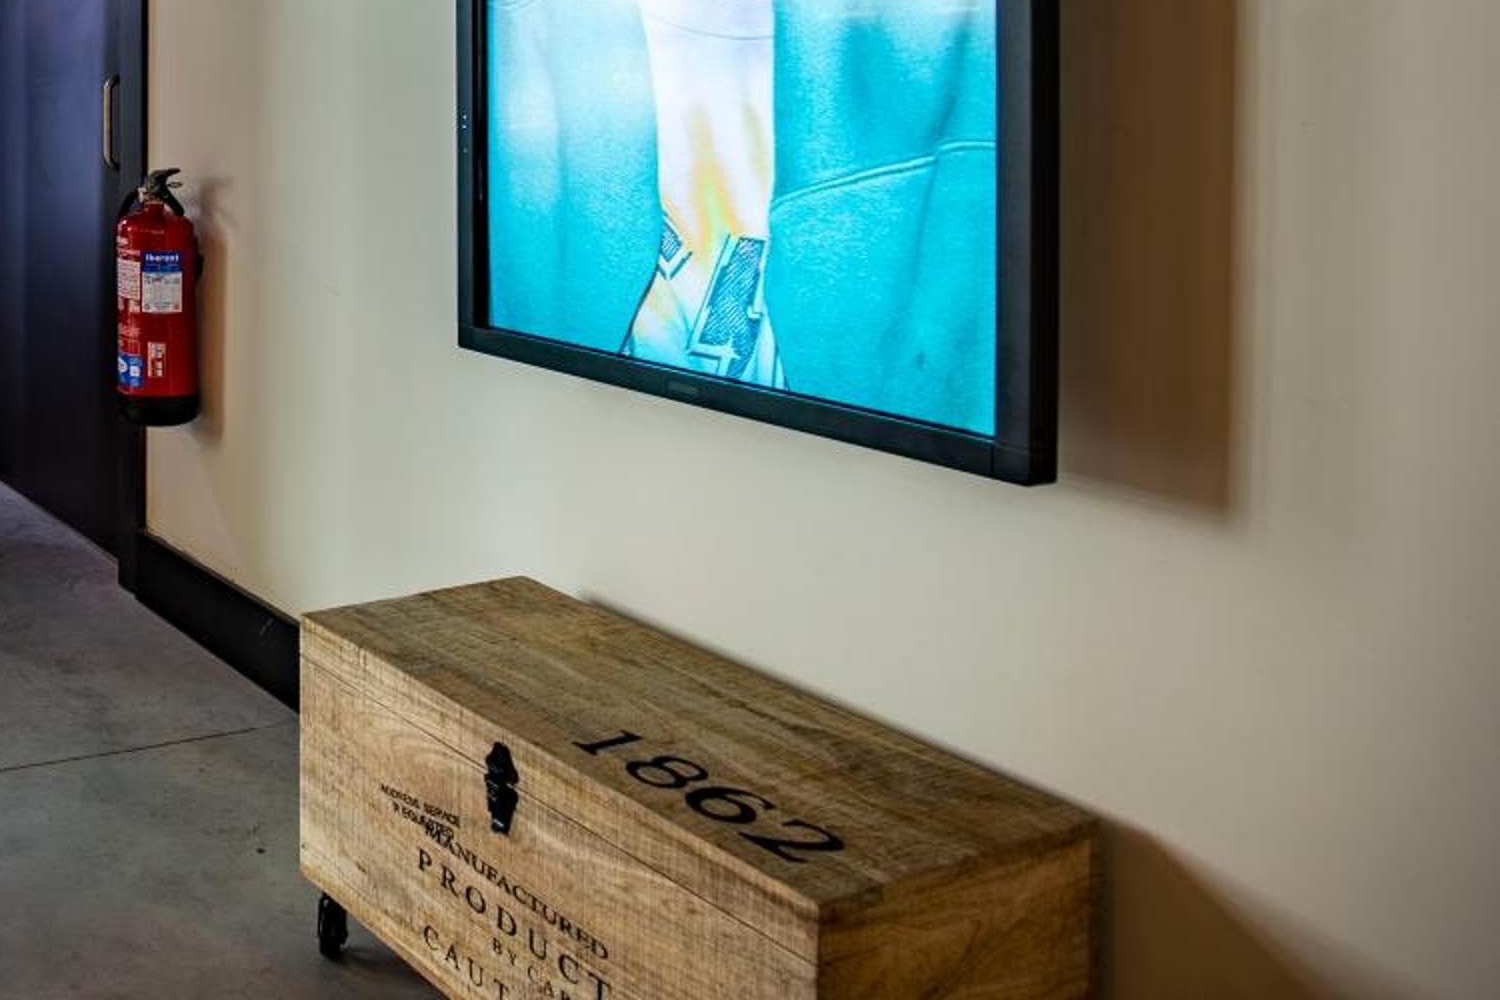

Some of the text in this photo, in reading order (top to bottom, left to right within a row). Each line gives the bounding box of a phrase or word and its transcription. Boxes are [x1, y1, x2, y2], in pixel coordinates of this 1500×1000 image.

[571, 729, 845, 863] 1862
[419, 849, 611, 1000] PRODUCT
[423, 818, 609, 960] MANUFACTURED
